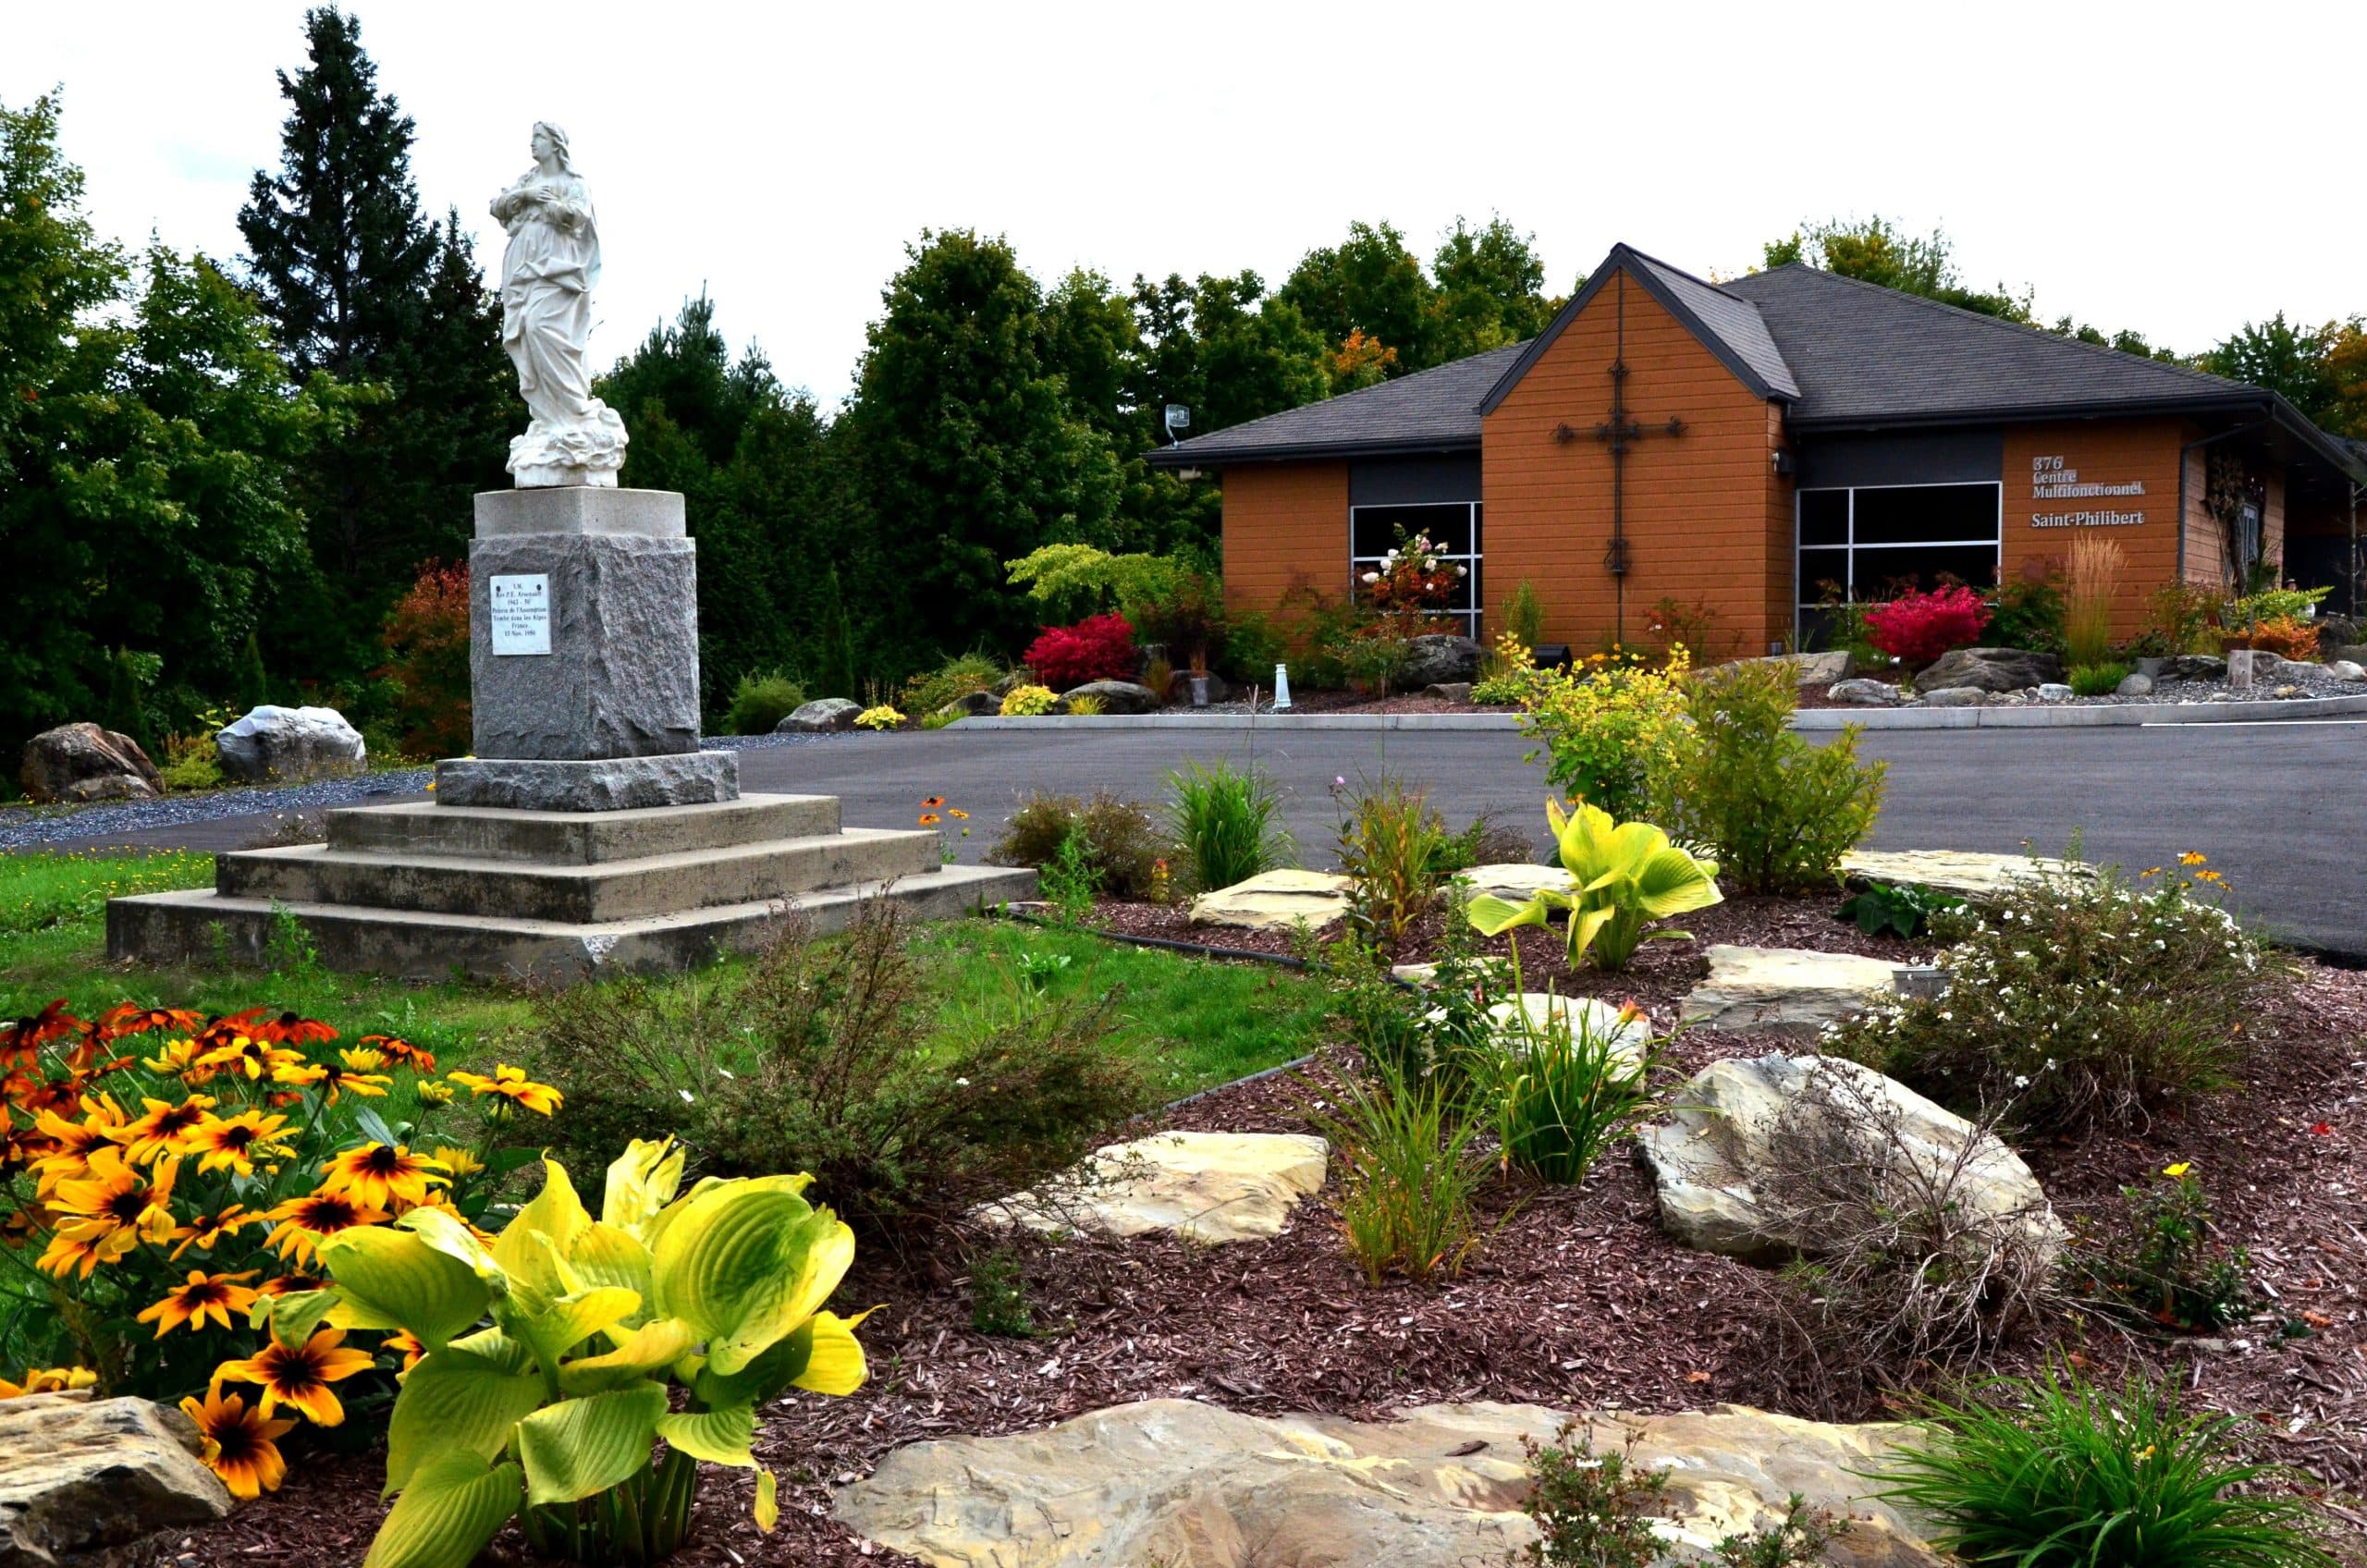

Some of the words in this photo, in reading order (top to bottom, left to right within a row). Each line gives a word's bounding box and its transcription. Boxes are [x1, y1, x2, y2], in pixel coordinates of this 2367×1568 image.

[2033, 456, 2063, 471] 376
[2033, 470, 2078, 484] Centre
[2033, 482, 2144, 498] Multifonctionnel
[2031, 510, 2144, 528] Saint-Philibert
